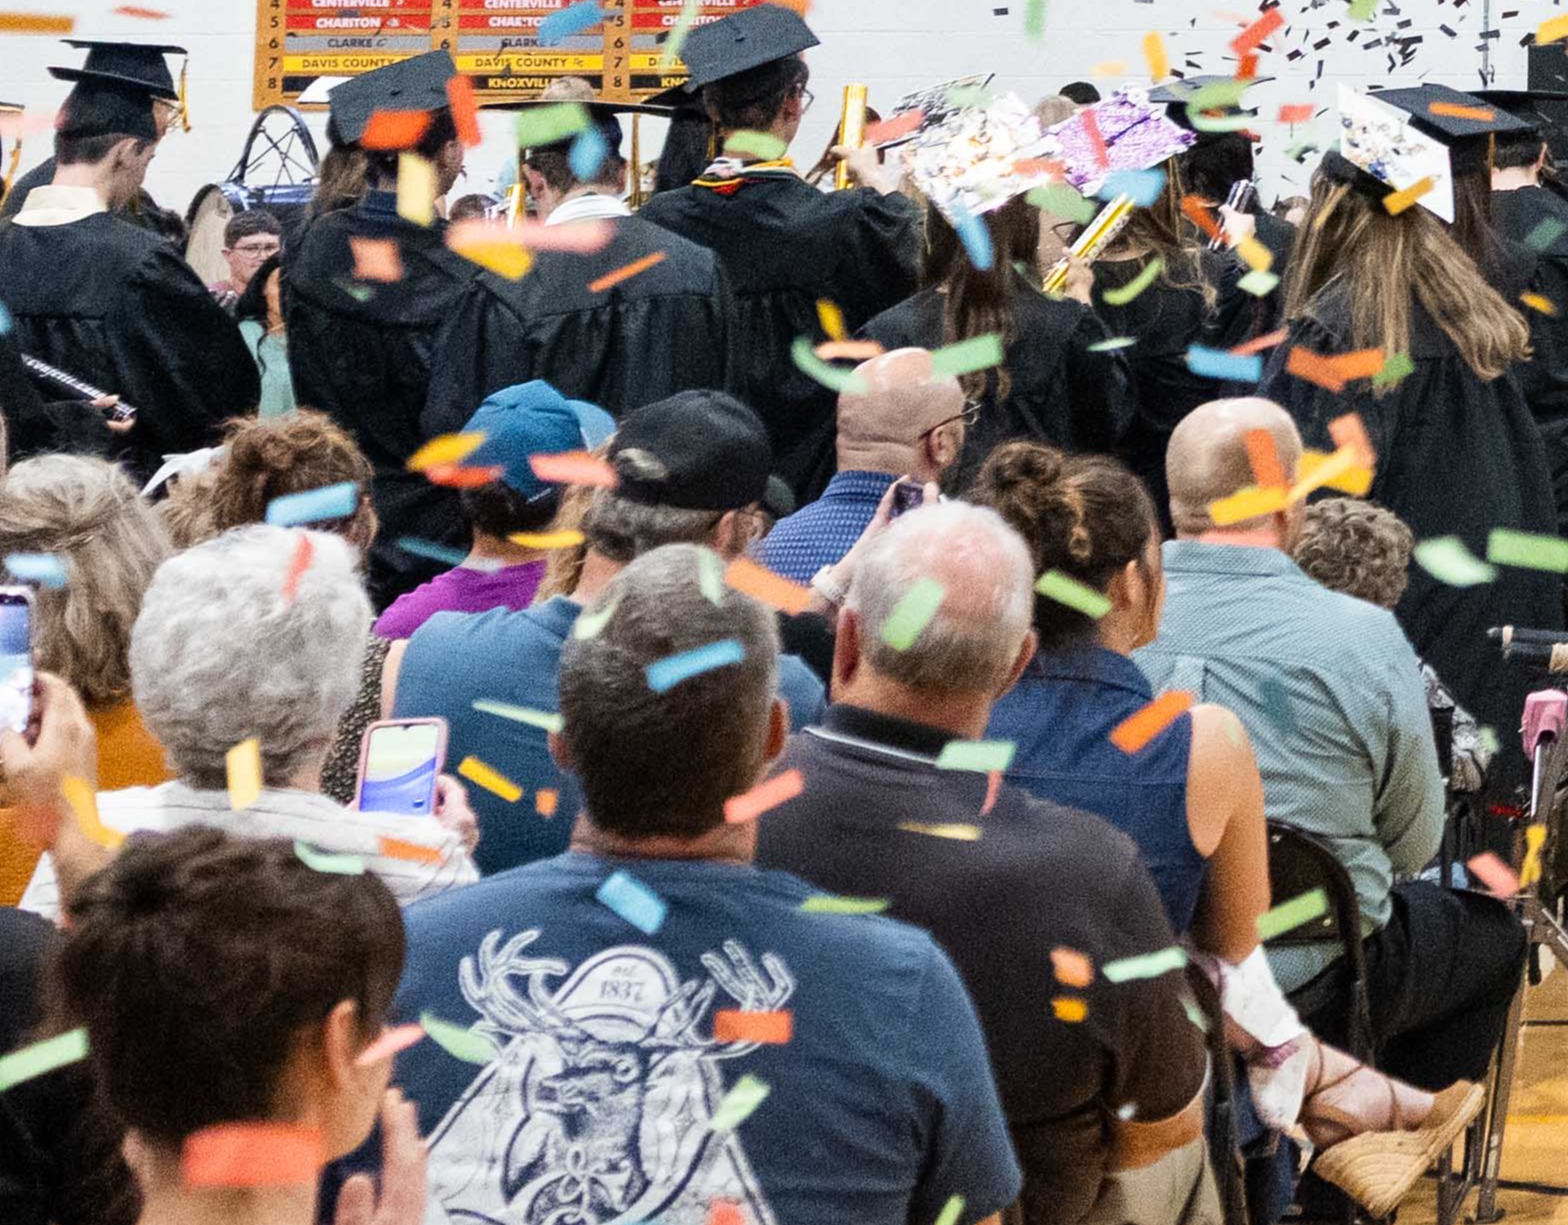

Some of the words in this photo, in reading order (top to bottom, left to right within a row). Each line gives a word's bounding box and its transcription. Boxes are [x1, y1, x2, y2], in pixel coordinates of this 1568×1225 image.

[271, 17, 279, 28] 5
[316, 17, 381, 28] CHARITON
[615, 15, 624, 26] 5
[269, 38, 279, 49] 6
[327, 38, 372, 48] CLARKE
[440, 38, 450, 49] 6
[614, 38, 624, 49] 6
[269, 57, 278, 69] 7
[302, 59, 339, 68] DAVIS
[475, 58, 511, 67] DAVIS
[516, 58, 567, 66] COUNTY
[614, 57, 623, 69] 7
[268, 78, 277, 89] 8
[488, 78, 554, 89] KNOXVILL
[613, 77, 622, 88] 8
